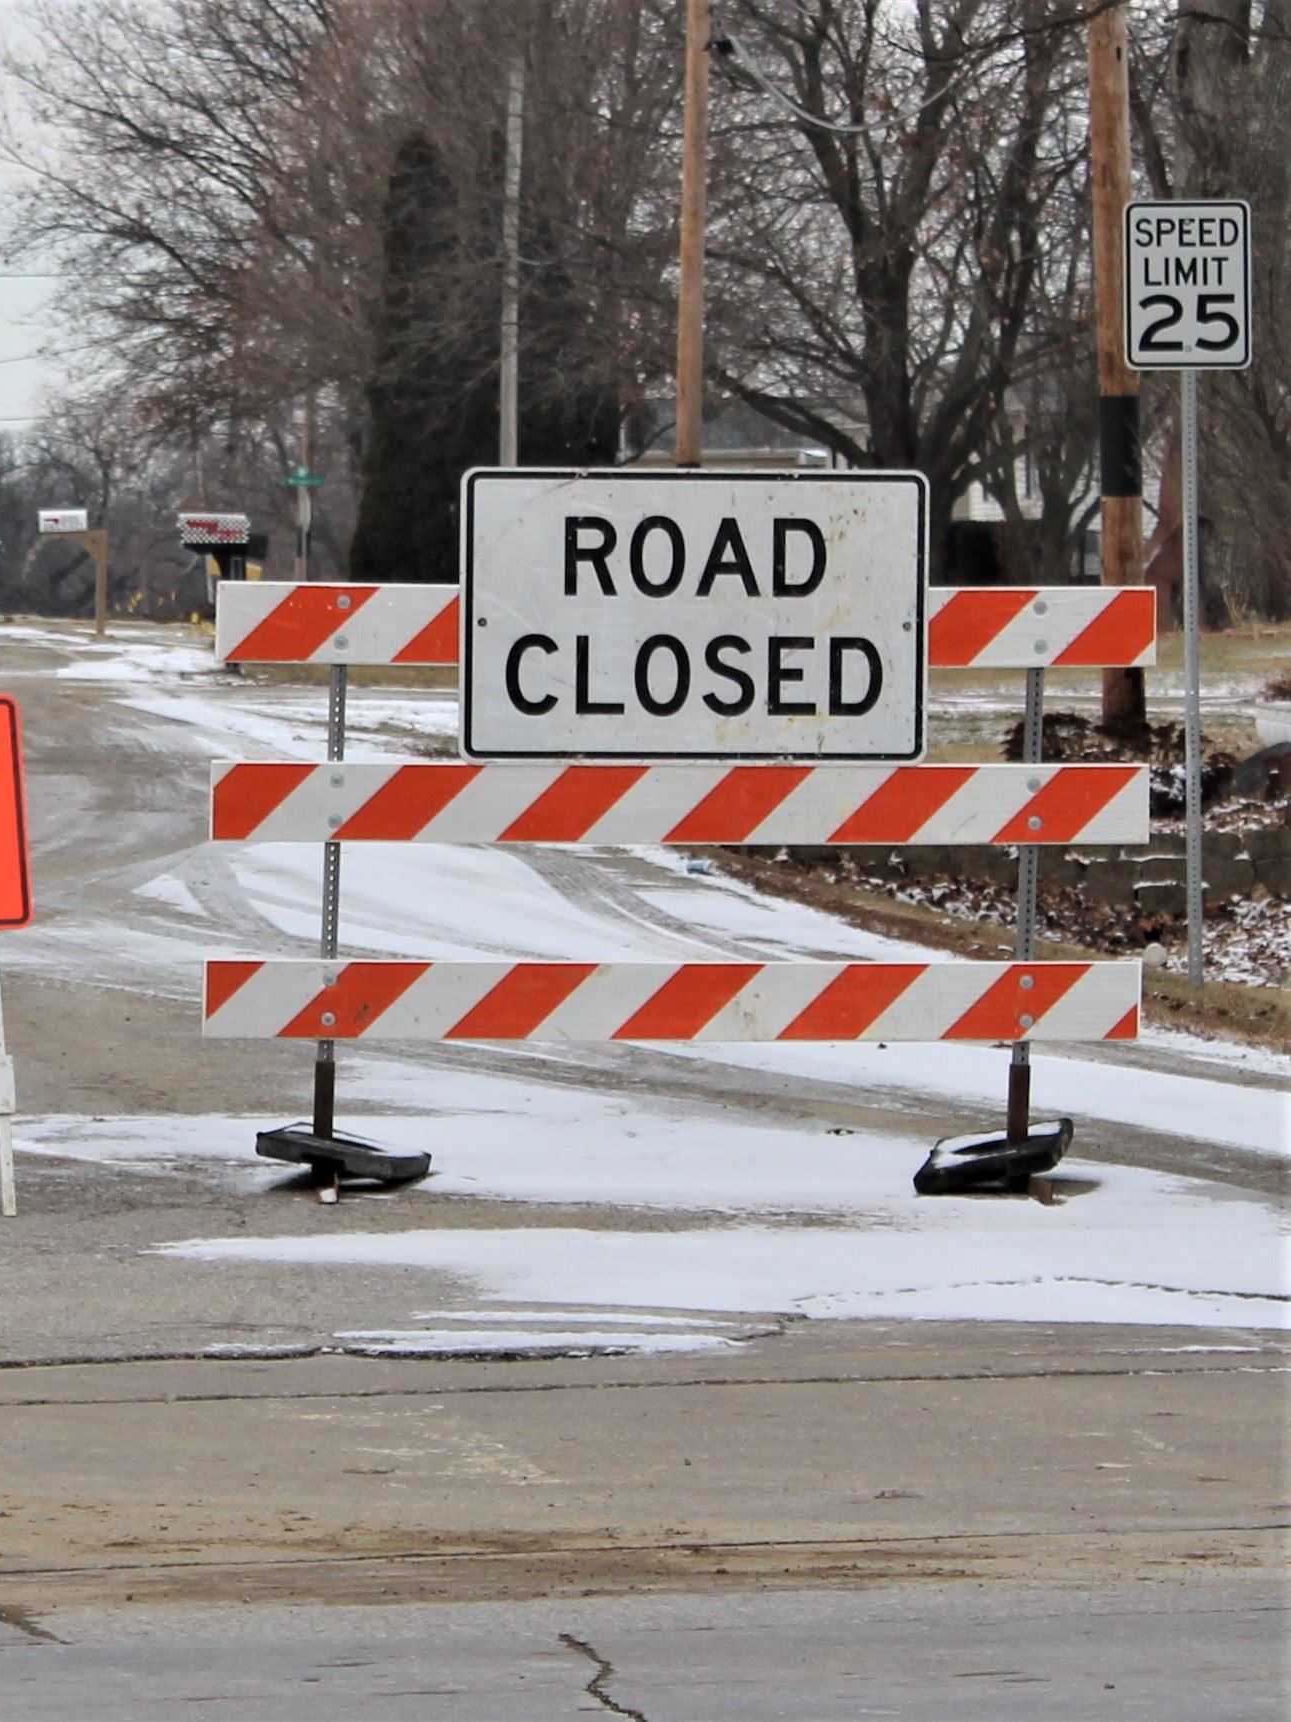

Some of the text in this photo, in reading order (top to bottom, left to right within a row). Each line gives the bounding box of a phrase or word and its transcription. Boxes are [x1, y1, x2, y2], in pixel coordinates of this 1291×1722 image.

[1135, 218, 1239, 248] SPEED
[1144, 257, 1229, 286] LIMIT
[1138, 294, 1241, 352] 25
[564, 515, 828, 599] ROAD
[505, 633, 884, 717] CLOSED
